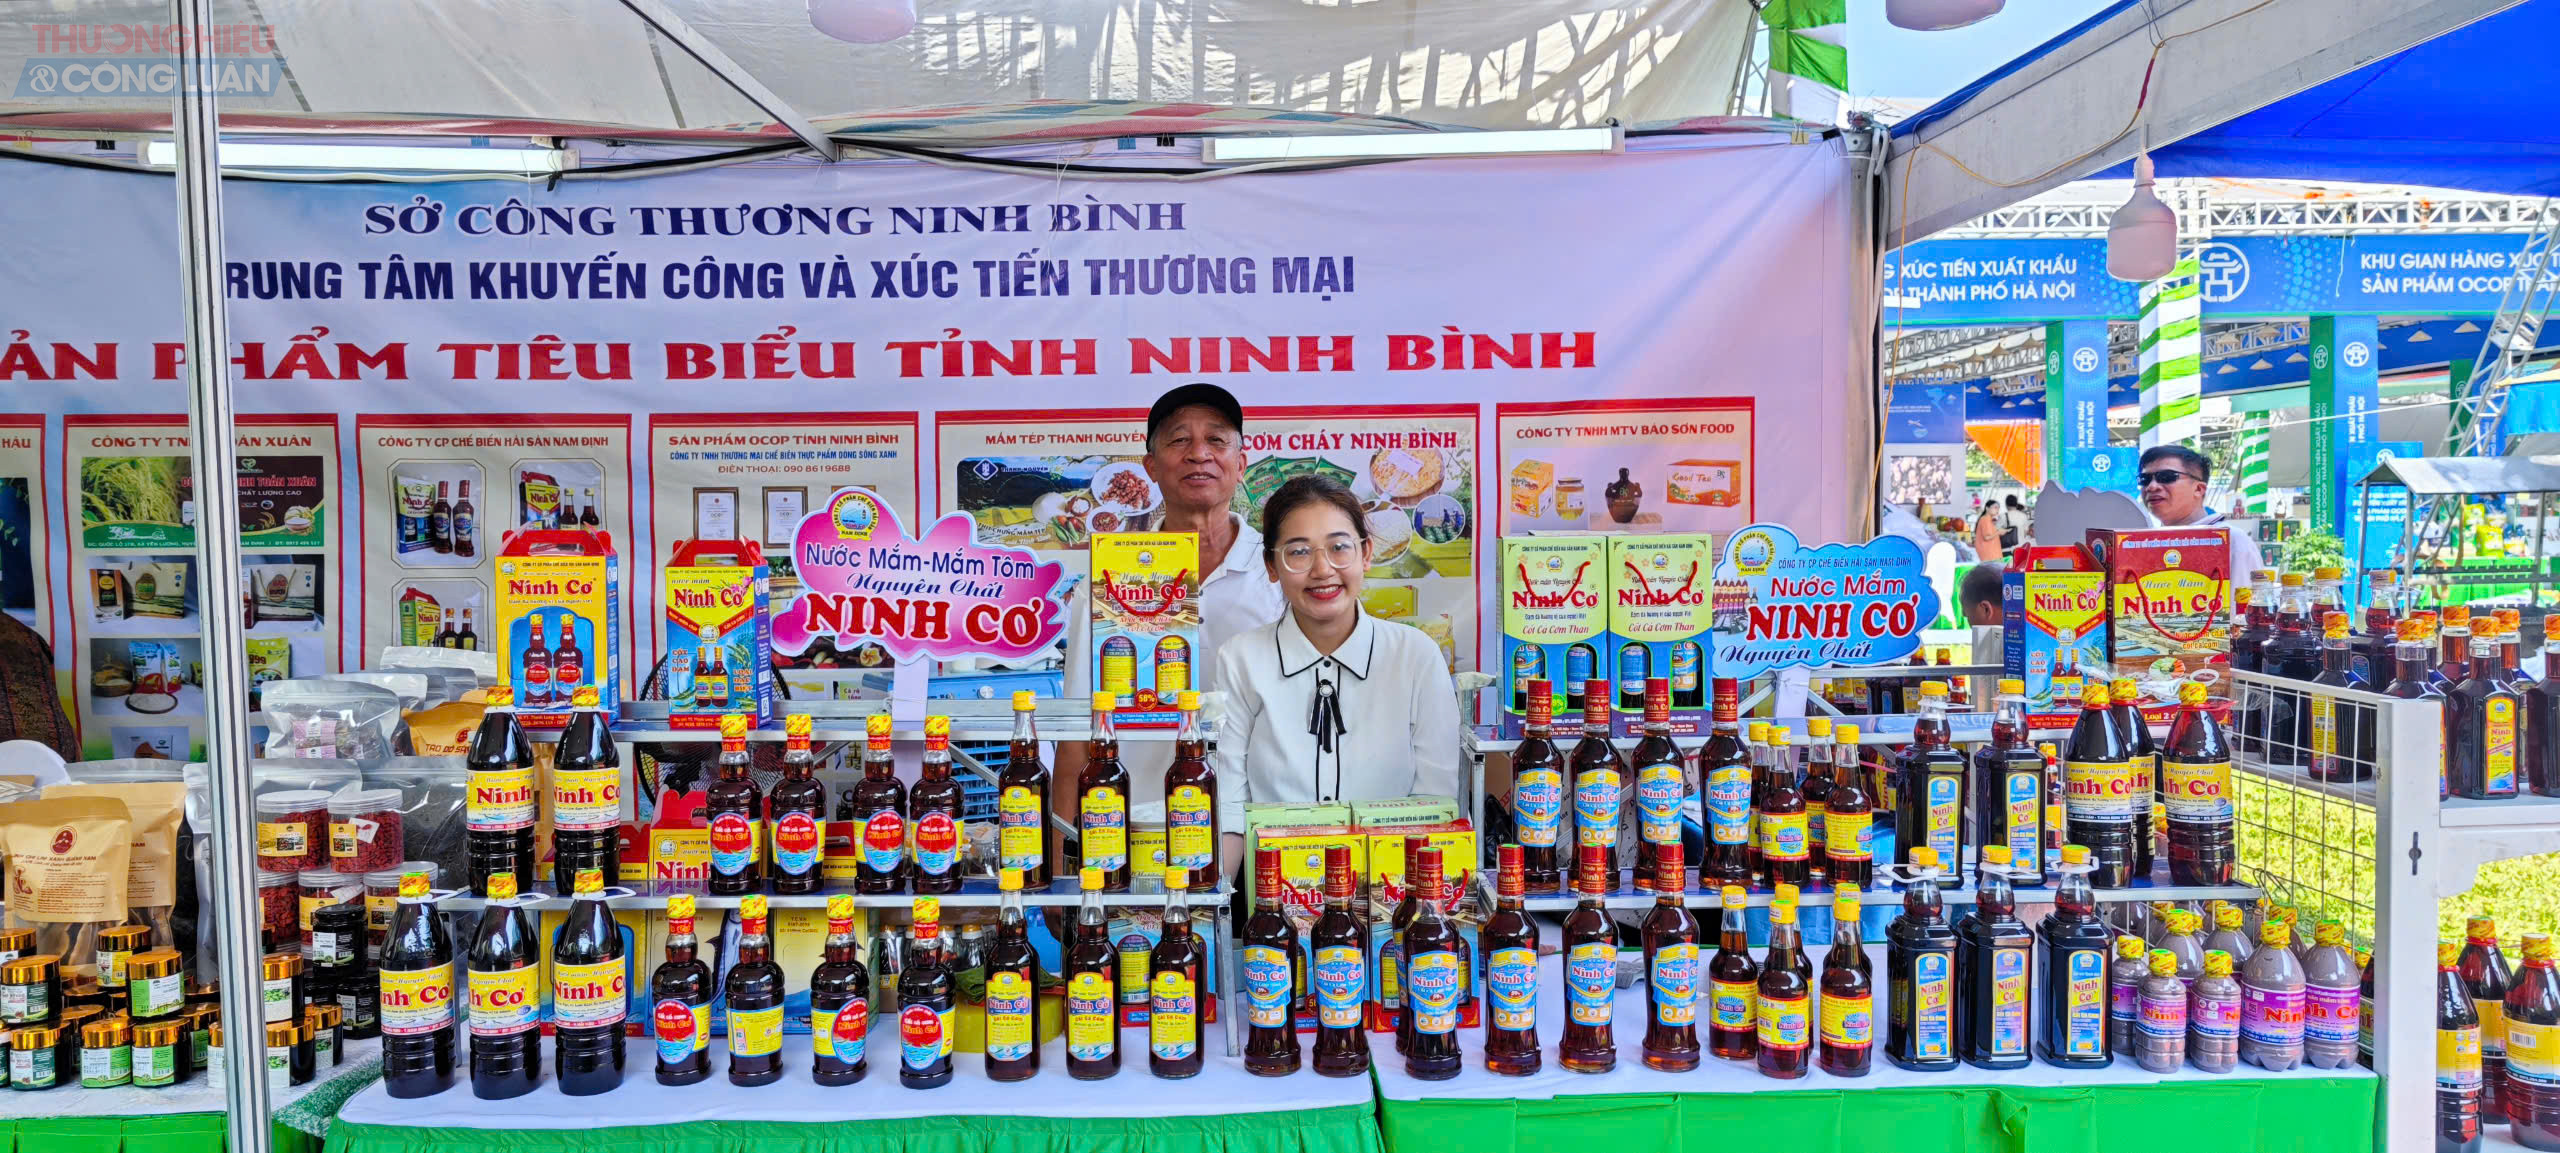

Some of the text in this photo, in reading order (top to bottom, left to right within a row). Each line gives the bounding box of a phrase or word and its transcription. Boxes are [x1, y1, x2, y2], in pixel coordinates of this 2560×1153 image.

[364, 194, 1188, 236] SỞ CÔNG THƯƠNG NINH BÌNH
[1941, 257, 1976, 279] TIẾN
[1980, 256, 2026, 277] XUẤT
[2029, 254, 2077, 276] KHẨU
[2361, 254, 2395, 270] KHU
[2399, 253, 2446, 269] GIAN
[2450, 249, 2505, 269] HÀNG
[227, 247, 1355, 301] RUNG TÂM KHUYẾN CÔNG VÀ XÚC TIẾN THƯƠNG MẠI
[2362, 273, 2399, 294] SẢN
[2402, 272, 2455, 294] PHẨM
[1970, 280, 2010, 303] PHỐ
[2013, 281, 2039, 301] HÀ
[2042, 281, 2076, 302] NỘI
[0, 329, 118, 381] ẢN
[435, 334, 634, 381] TIÊU
[663, 324, 857, 380] BIỂU
[884, 326, 1098, 379] TỈNH
[1126, 334, 1355, 376] NINH
[1385, 324, 1597, 373] BÌNH
[91, 435, 312, 448] CÔNG TY XUÂN
[378, 435, 413, 448] CÔNG
[416, 437, 433, 447] TY
[434, 437, 450, 447] CP
[451, 434, 474, 447] CHẾ
[475, 434, 503, 447] BIẾN
[553, 436, 579, 447] NAM
[581, 436, 609, 449] ĐỊNH
[703, 432, 747, 447] PHẨM
[749, 435, 790, 446] OCOP
[829, 434, 864, 446] NINH
[865, 431, 899, 445] BÌNH
[1019, 431, 1046, 445] TÉP
[1047, 432, 1094, 445] THANH
[1243, 426, 1457, 452] CƠM CHÁY NINH BÌNH
[1516, 426, 1553, 440] CÔNG
[1554, 427, 1571, 439] TY
[1576, 426, 1608, 438] TNHH
[1610, 425, 1638, 437] MTV
[1699, 422, 1735, 436] FOOD
[670, 450, 690, 462] CÔNG
[690, 452, 700, 461] TY
[701, 452, 719, 462] TNHH
[879, 449, 898, 460] XANH
[783, 464, 804, 474] 090
[805, 543, 863, 568] Nước
[992, 555, 1035, 580] Tôm
[1798, 560, 1806, 569] TY
[508, 578, 593, 596] Ninh Cơ
[847, 572, 1005, 600] Nguyên Chất
[1770, 568, 1907, 598] Nước Mắm
[673, 587, 745, 609] Ninh Cơ
[1570, 590, 1600, 608] Cơ
[2033, 592, 2099, 611] Ninh Cơ
[805, 592, 1045, 646] NINH CƠ
[1745, 594, 1920, 641] NINH CƠ
[1720, 639, 1873, 665] Nguyên Chất
[477, 785, 532, 804] Ninh
[2188, 779, 2222, 797] Cơ
[419, 982, 451, 1002] Cơ
